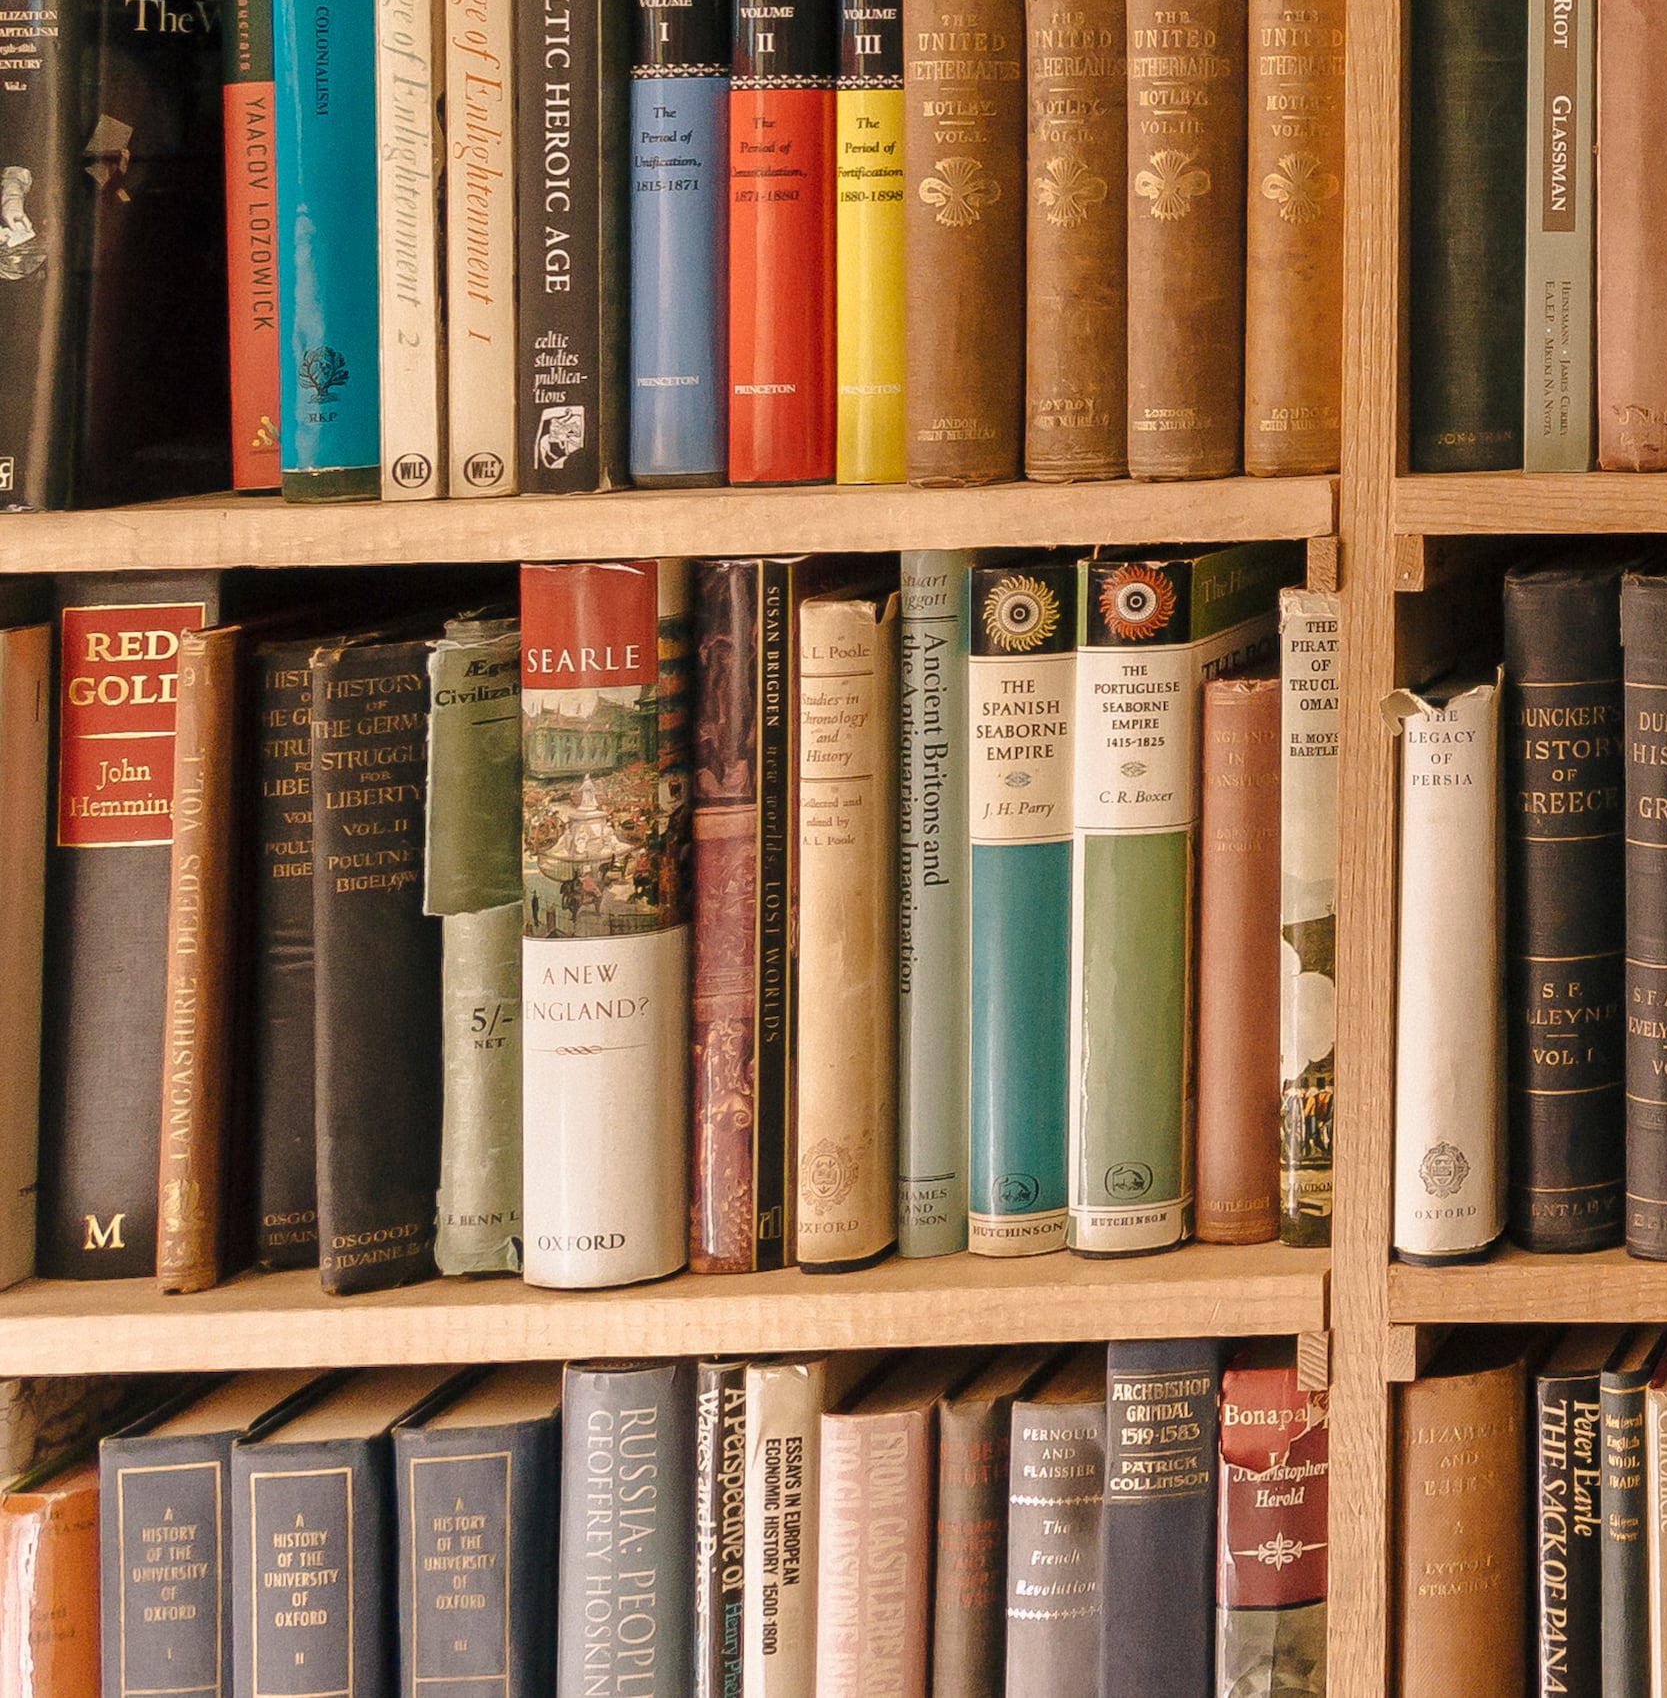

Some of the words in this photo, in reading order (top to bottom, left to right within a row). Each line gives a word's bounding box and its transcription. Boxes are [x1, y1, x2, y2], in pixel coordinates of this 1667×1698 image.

[544, 83, 571, 212] HEROIC
[544, 226, 571, 294] AGE
[86, 631, 178, 662] RED
[527, 645, 641, 673] SEARLE
[1001, 679, 1036, 694] THE
[982, 700, 1061, 718] SPANISH
[976, 721, 1067, 740] SEABORNE
[986, 744, 1054, 762] EMPIRE
[99, 760, 151, 784] John
[544, 966, 556, 984] A
[563, 963, 619, 984] NEW
[1573, 1400, 1599, 1463] Peter
[1255, 1490, 1304, 1508] Herold
[1573, 1469, 1601, 1537] Earle
[274, 1532, 327, 1549] HISTORY
[275, 1609, 328, 1626] OXFORD
